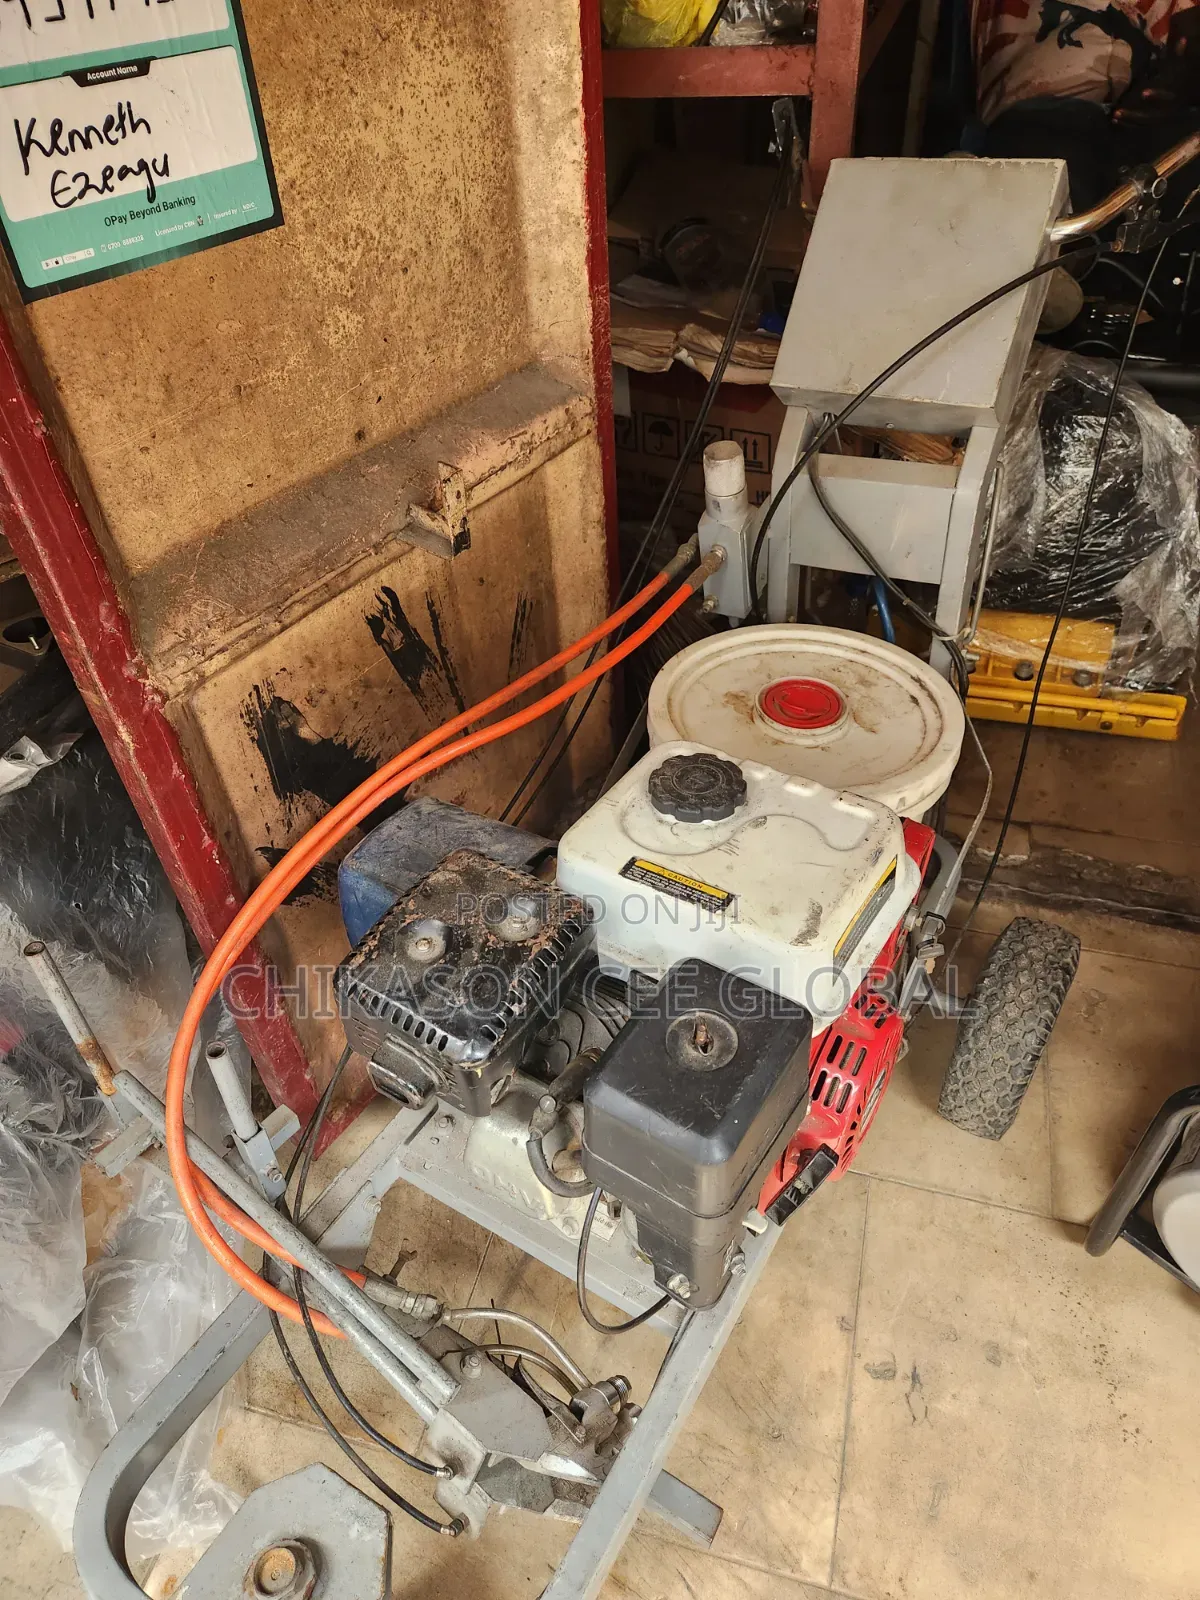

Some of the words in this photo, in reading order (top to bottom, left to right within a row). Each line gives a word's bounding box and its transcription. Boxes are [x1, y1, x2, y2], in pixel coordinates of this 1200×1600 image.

[87, 68, 116, 82] Account
[116, 64, 139, 77] Name
[13, 100, 152, 177] Kenneth
[50, 153, 170, 208] Ezeagu
[103, 210, 128, 228] OPay
[129, 205, 162, 224] Beyond
[163, 195, 196, 212] Banking
[667, 872, 704, 890] CAUTION
